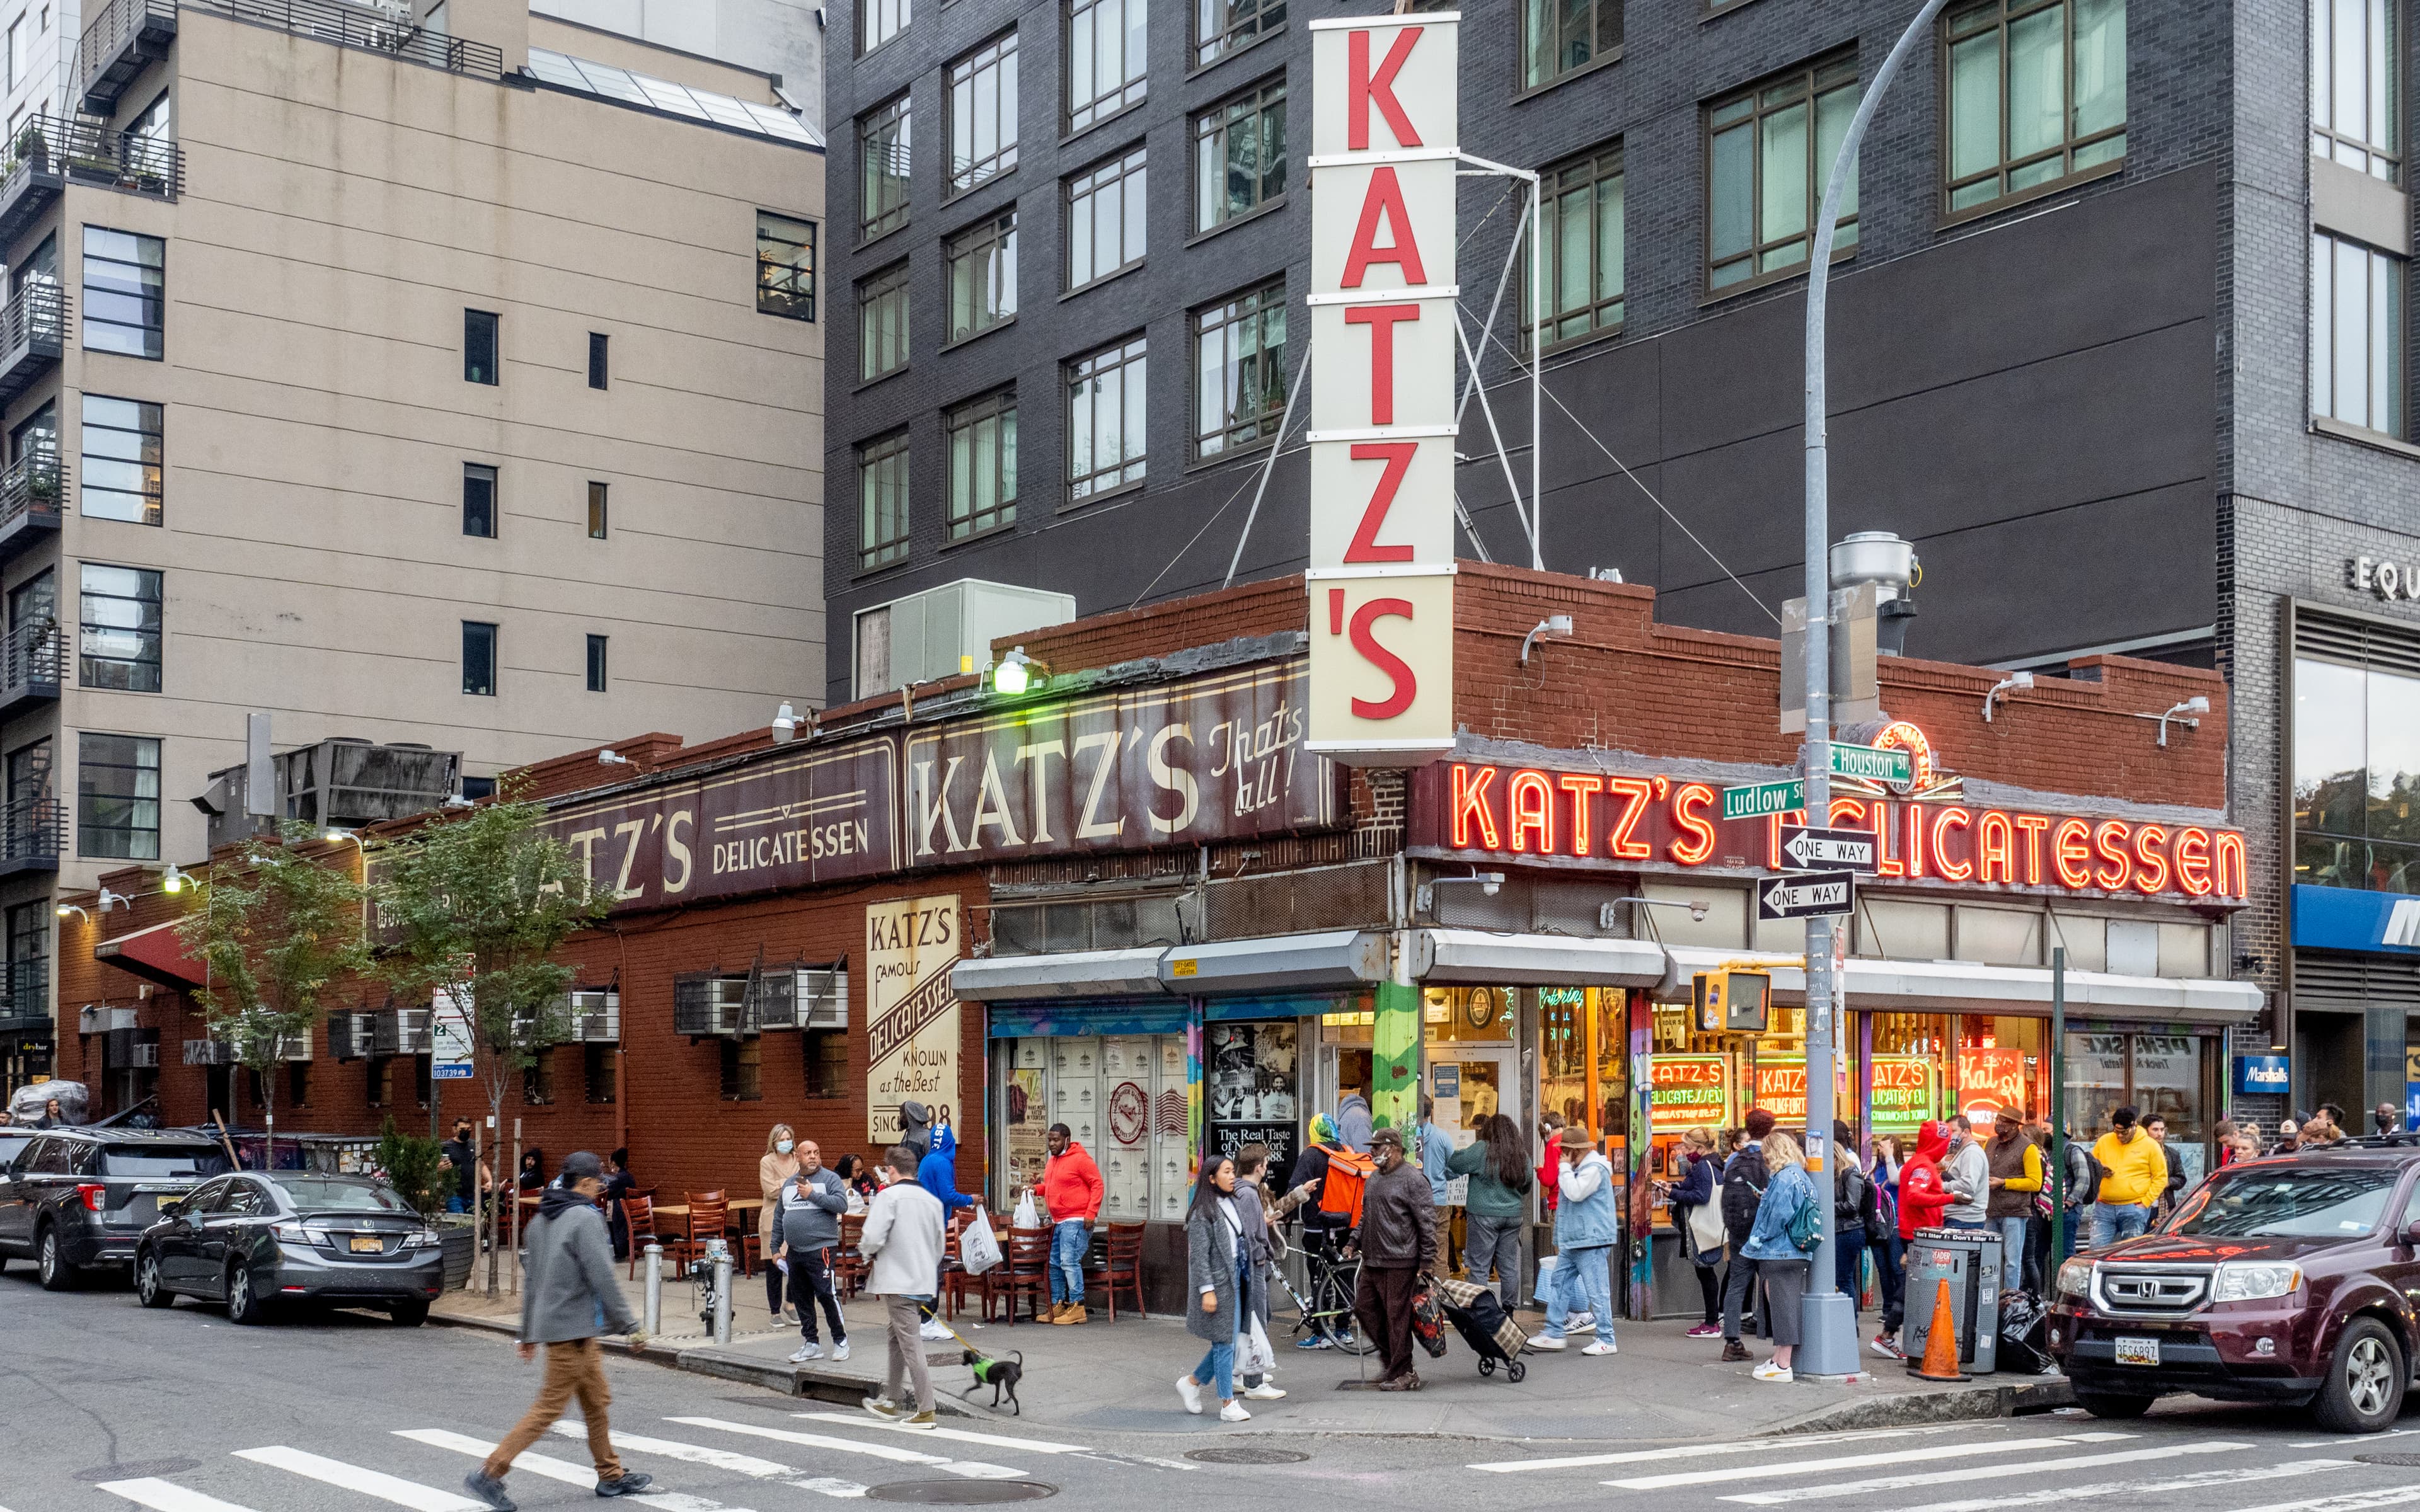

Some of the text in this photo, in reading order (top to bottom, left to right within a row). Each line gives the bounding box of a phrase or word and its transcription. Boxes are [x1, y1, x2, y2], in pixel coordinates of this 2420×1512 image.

[1329, 27, 1427, 719] KATZ'S
[1209, 701, 1302, 777] That's
[1830, 746, 1907, 777] E Houston St
[914, 721, 1199, 856] KATZ'S
[1727, 783, 1804, 816] Ludlow St
[1452, 764, 1716, 865] KATZ'S
[713, 818, 868, 874] DELICATESSEN
[1795, 840, 1866, 861] ONE WAY
[1773, 885, 1841, 906] ONE WAY
[870, 907, 952, 953] KATZ'S
[870, 968, 955, 1063] DELICATESSEN
[436, 1026, 444, 1036] 2
[23, 1043, 48, 1053] drybar
[903, 1048, 947, 1067] KNOWN
[880, 1070, 941, 1092] as the Best
[1761, 1067, 1807, 1093] KATZ'
[1874, 1062, 1924, 1086] ATZ'S
[2246, 1067, 2288, 1082] Marshalls
[1652, 1088, 1723, 1104] ELICATESSEN
[1872, 1089, 1925, 1105] LICATESSEN
[1218, 1128, 1291, 1140] The Real Taste
[1221, 1141, 1233, 1151] of
[1262, 1140, 1288, 1151] York.
